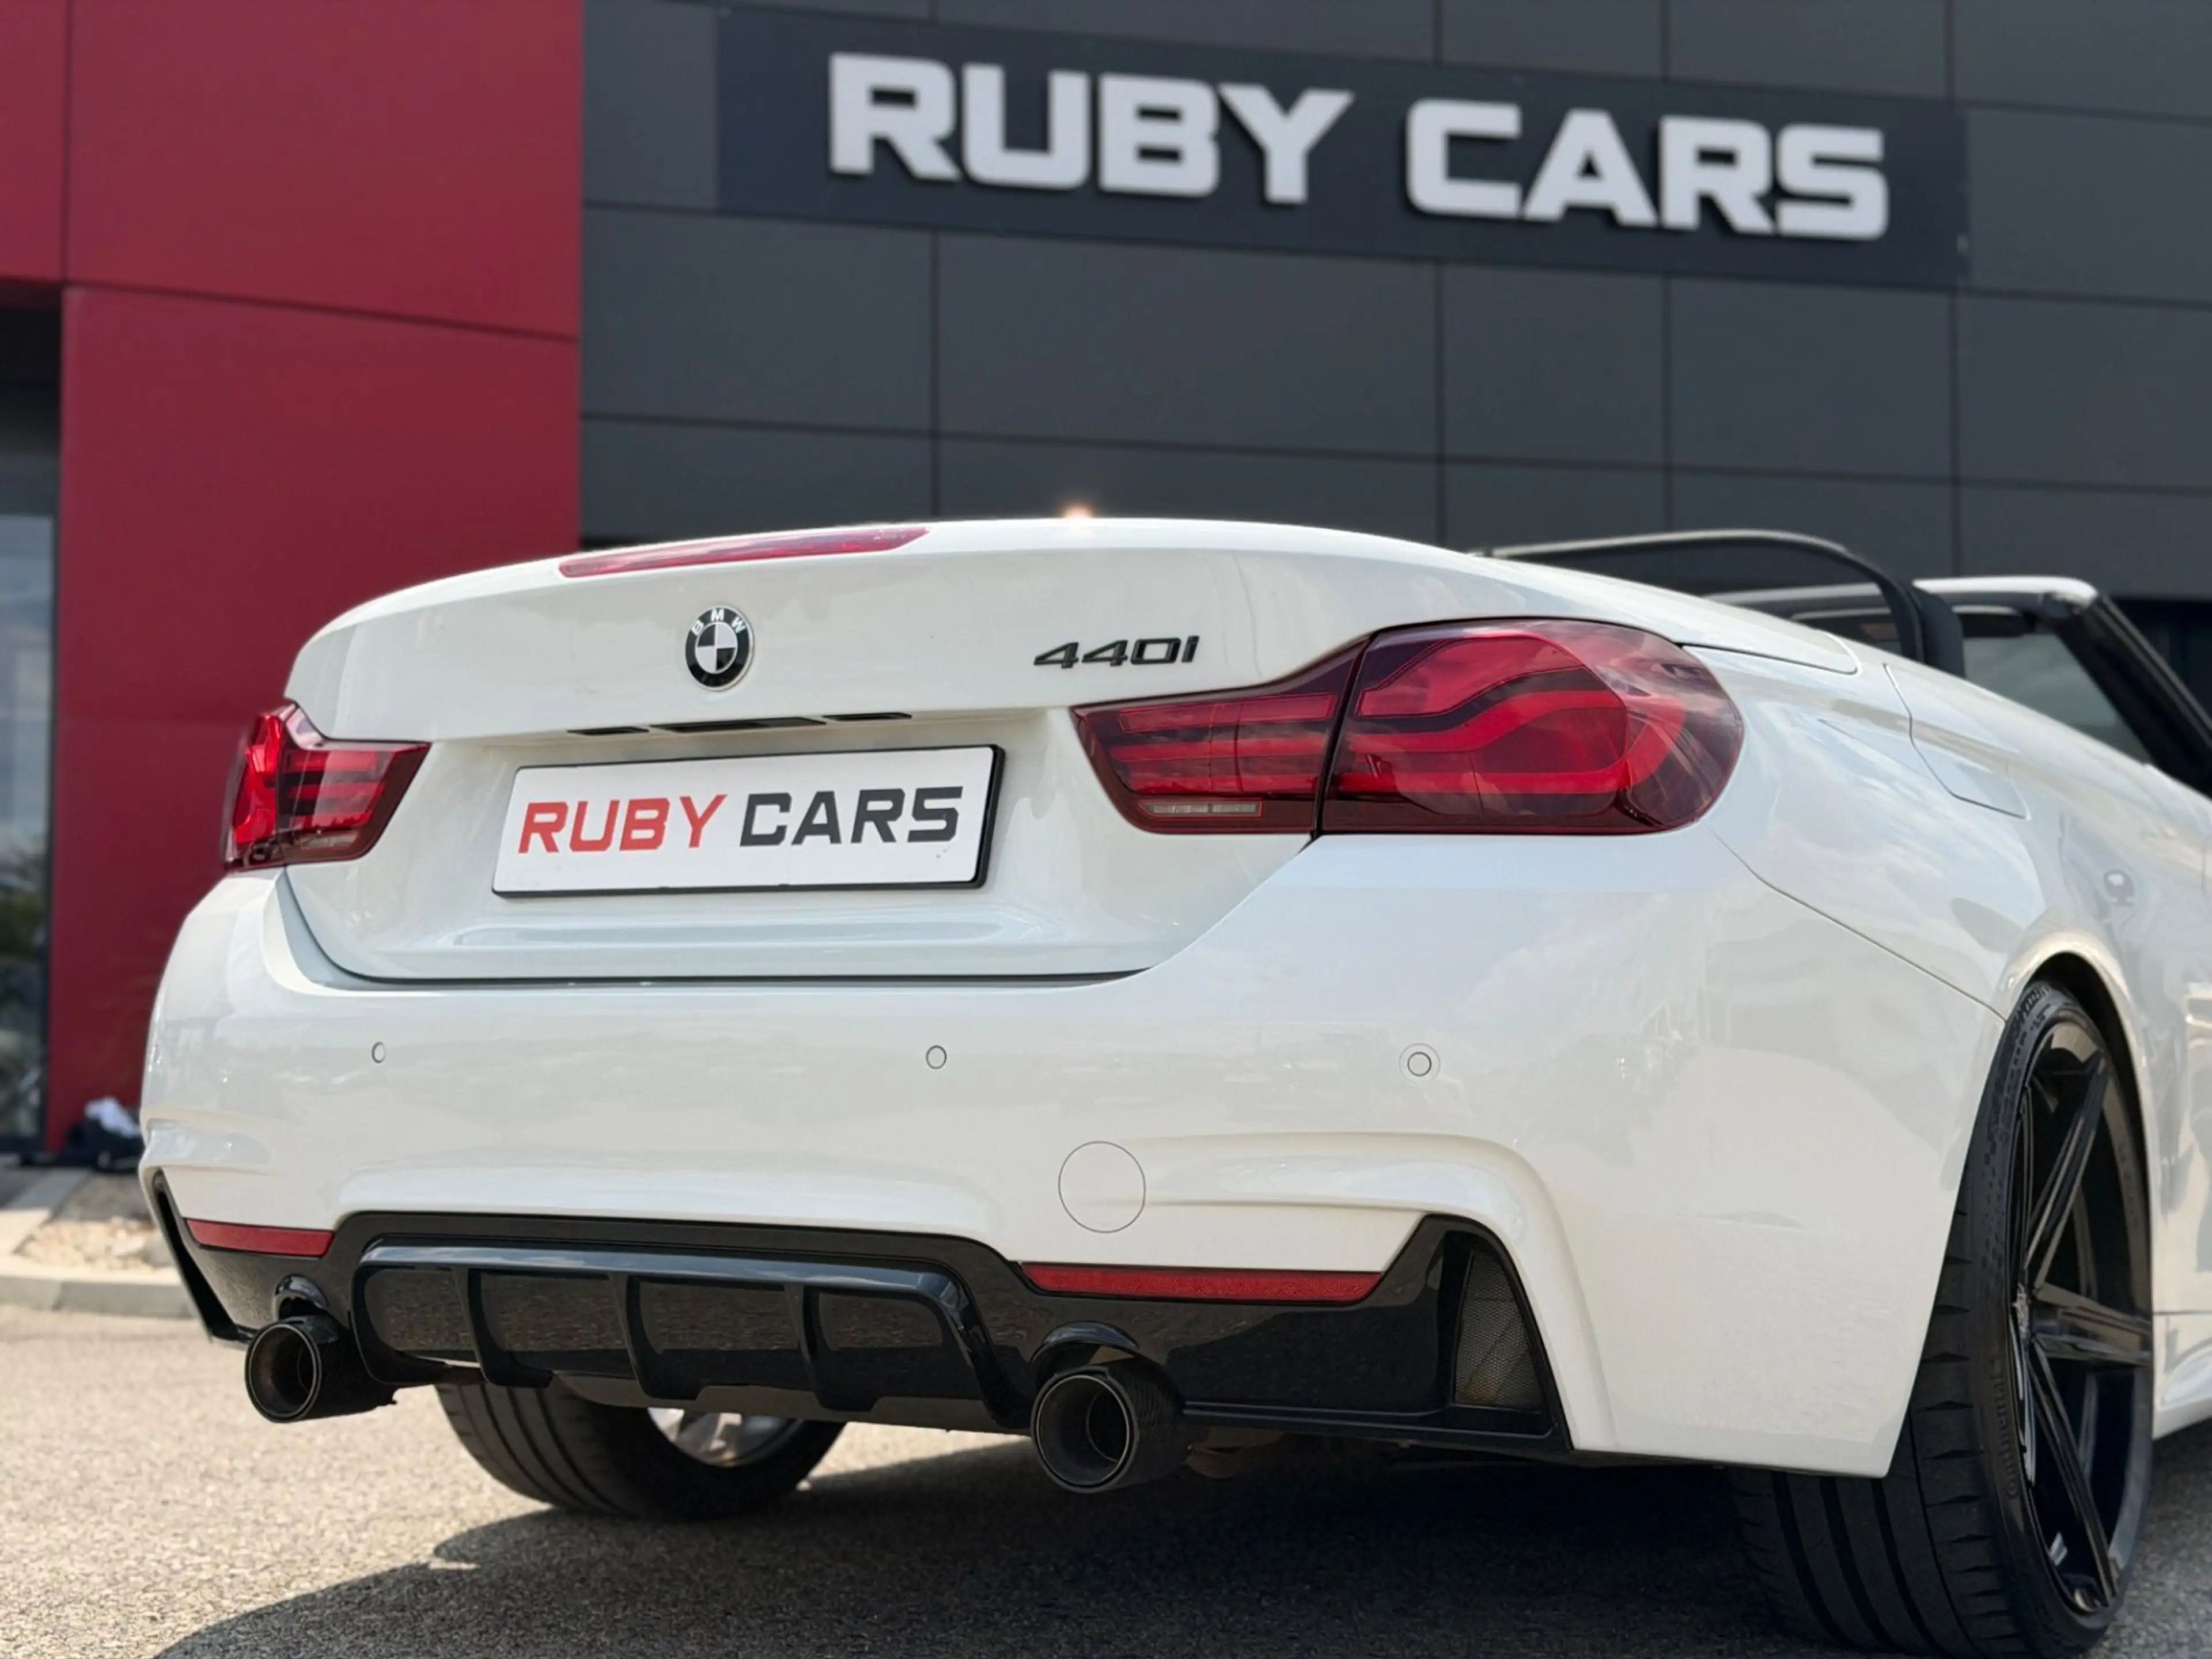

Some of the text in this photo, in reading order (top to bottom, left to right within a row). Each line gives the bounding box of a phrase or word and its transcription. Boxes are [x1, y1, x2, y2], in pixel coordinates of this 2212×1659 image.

[830, 54, 1888, 238] RUBY CARS
[691, 608, 747, 635] BMW
[518, 786, 964, 853] RUBY CARS
